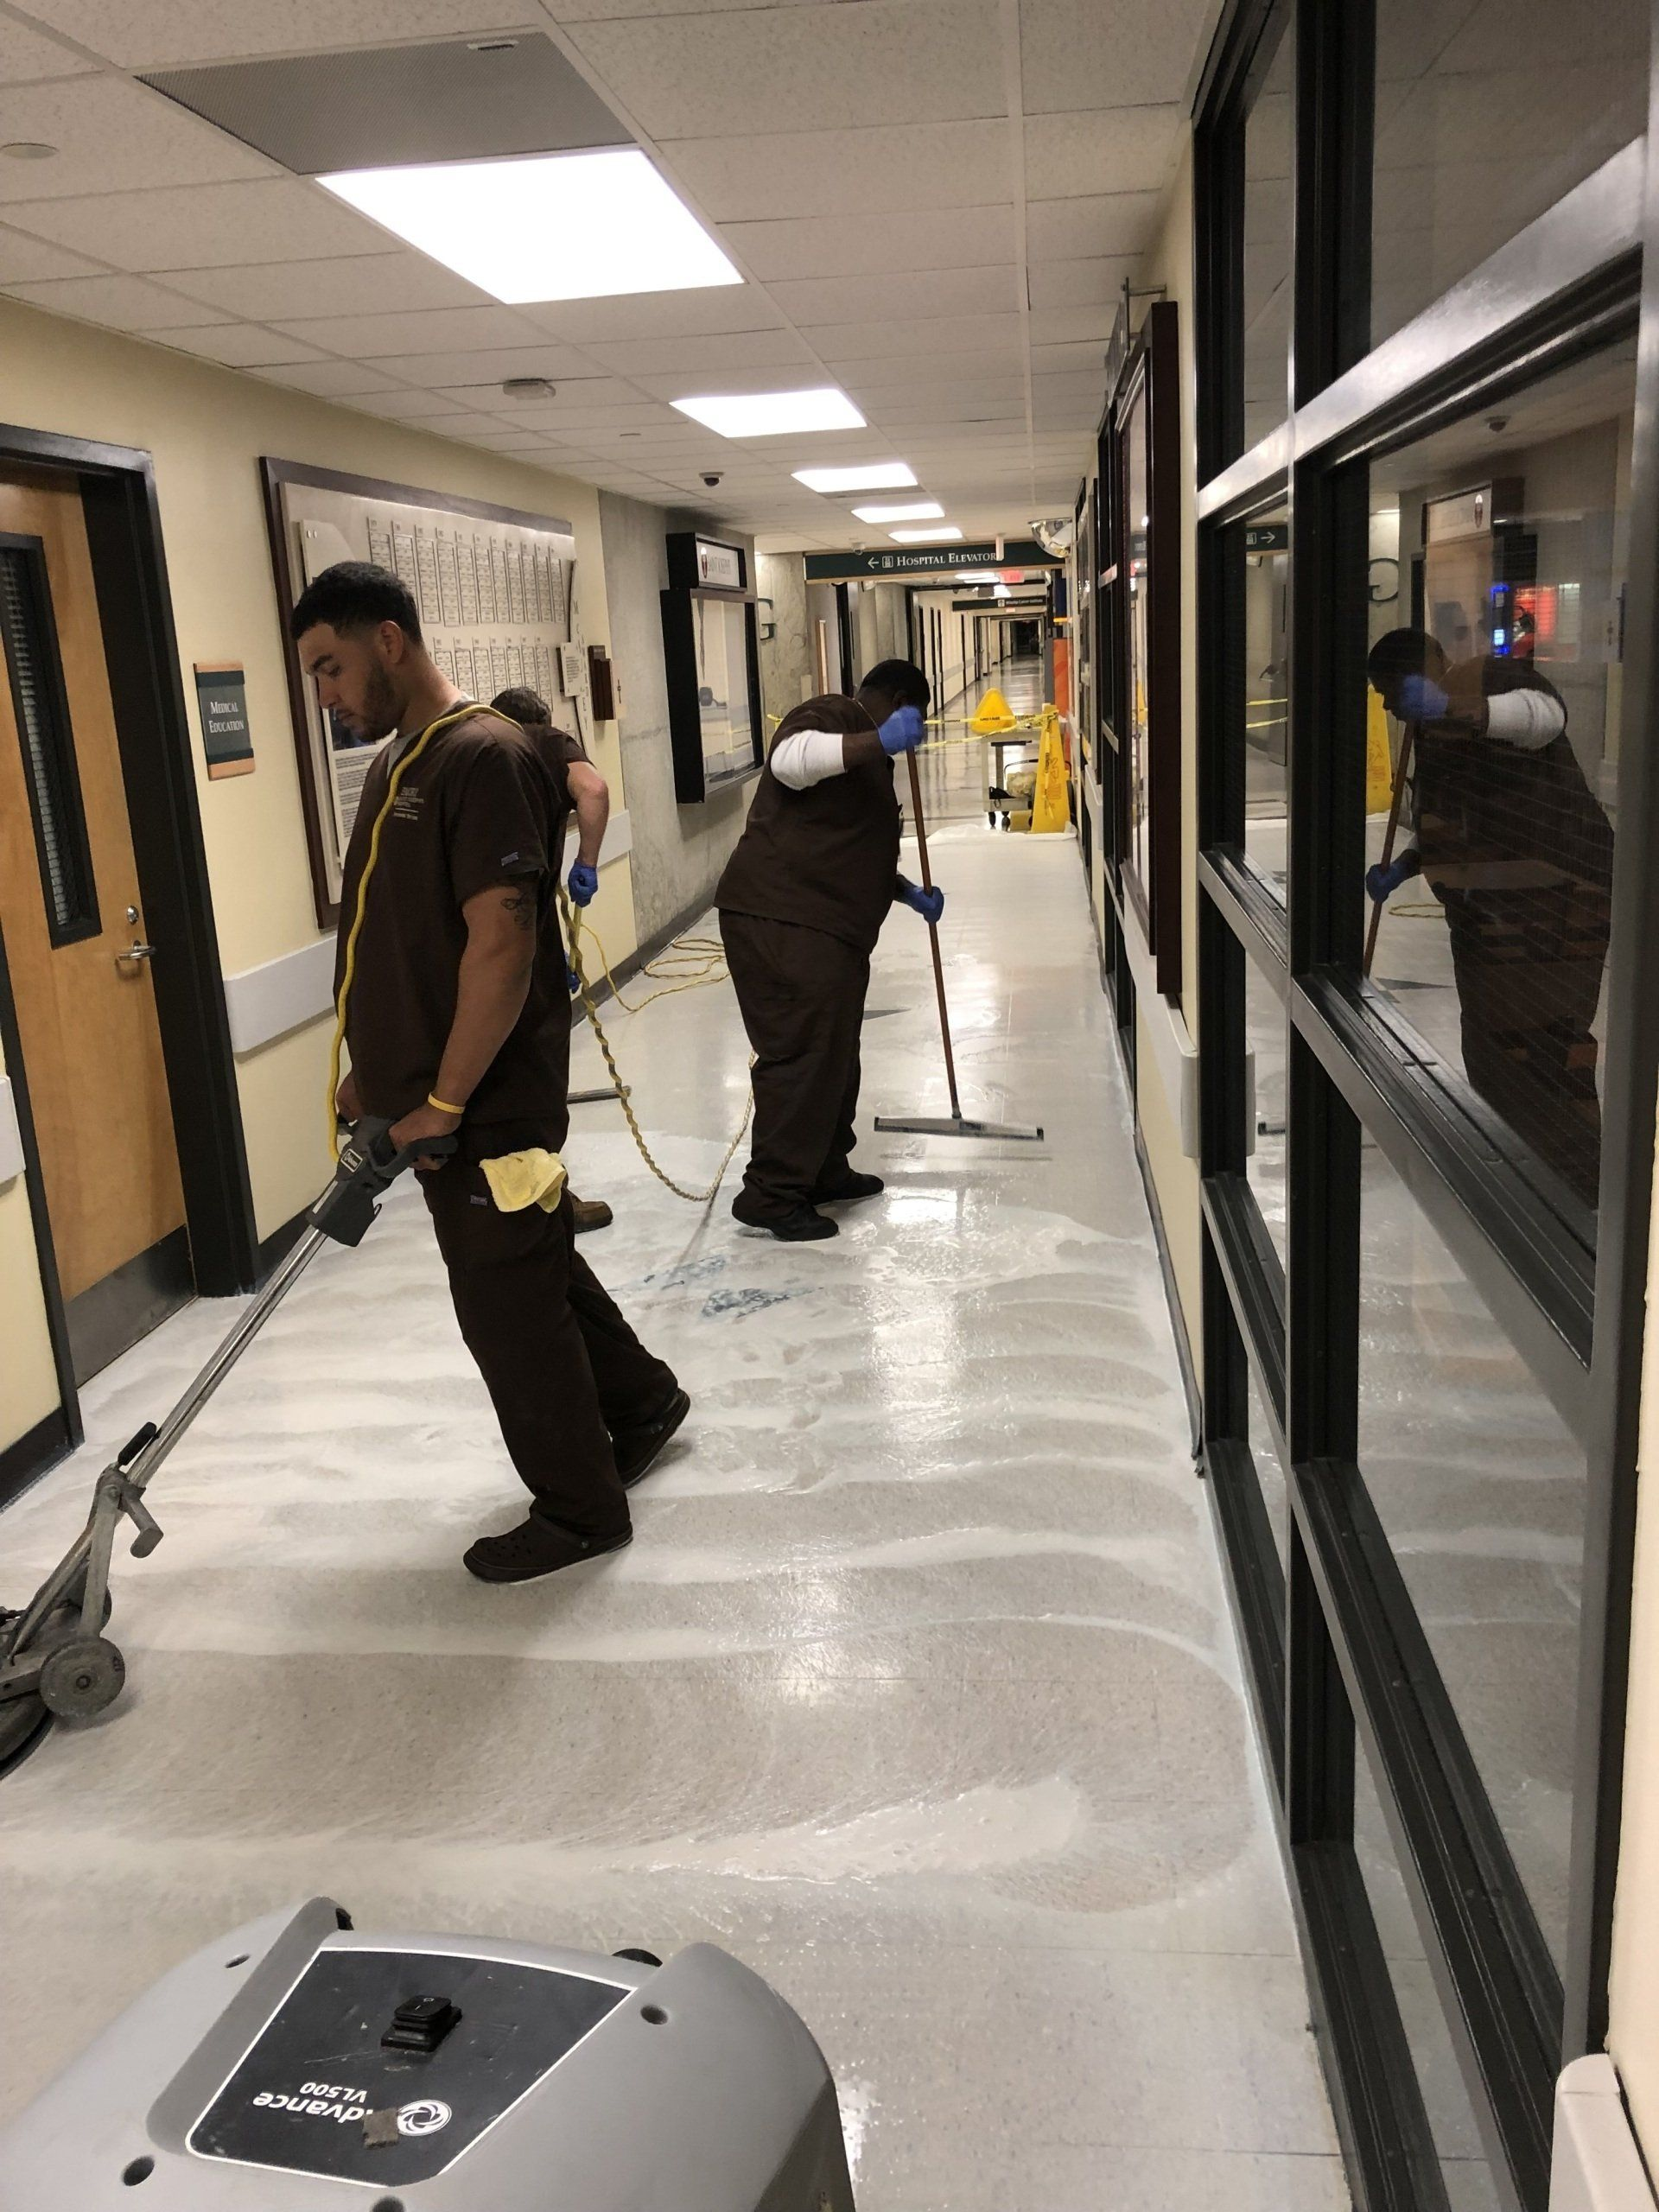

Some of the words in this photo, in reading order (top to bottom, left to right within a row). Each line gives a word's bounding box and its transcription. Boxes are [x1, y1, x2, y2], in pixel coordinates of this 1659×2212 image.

[896, 556, 946, 567] HOSPITAL
[210, 701, 239, 715] MEDICAL
[208, 720, 245, 734] EDUCATION
[299, 2082, 368, 2103] VL500
[252, 2092, 374, 2124] dvance
